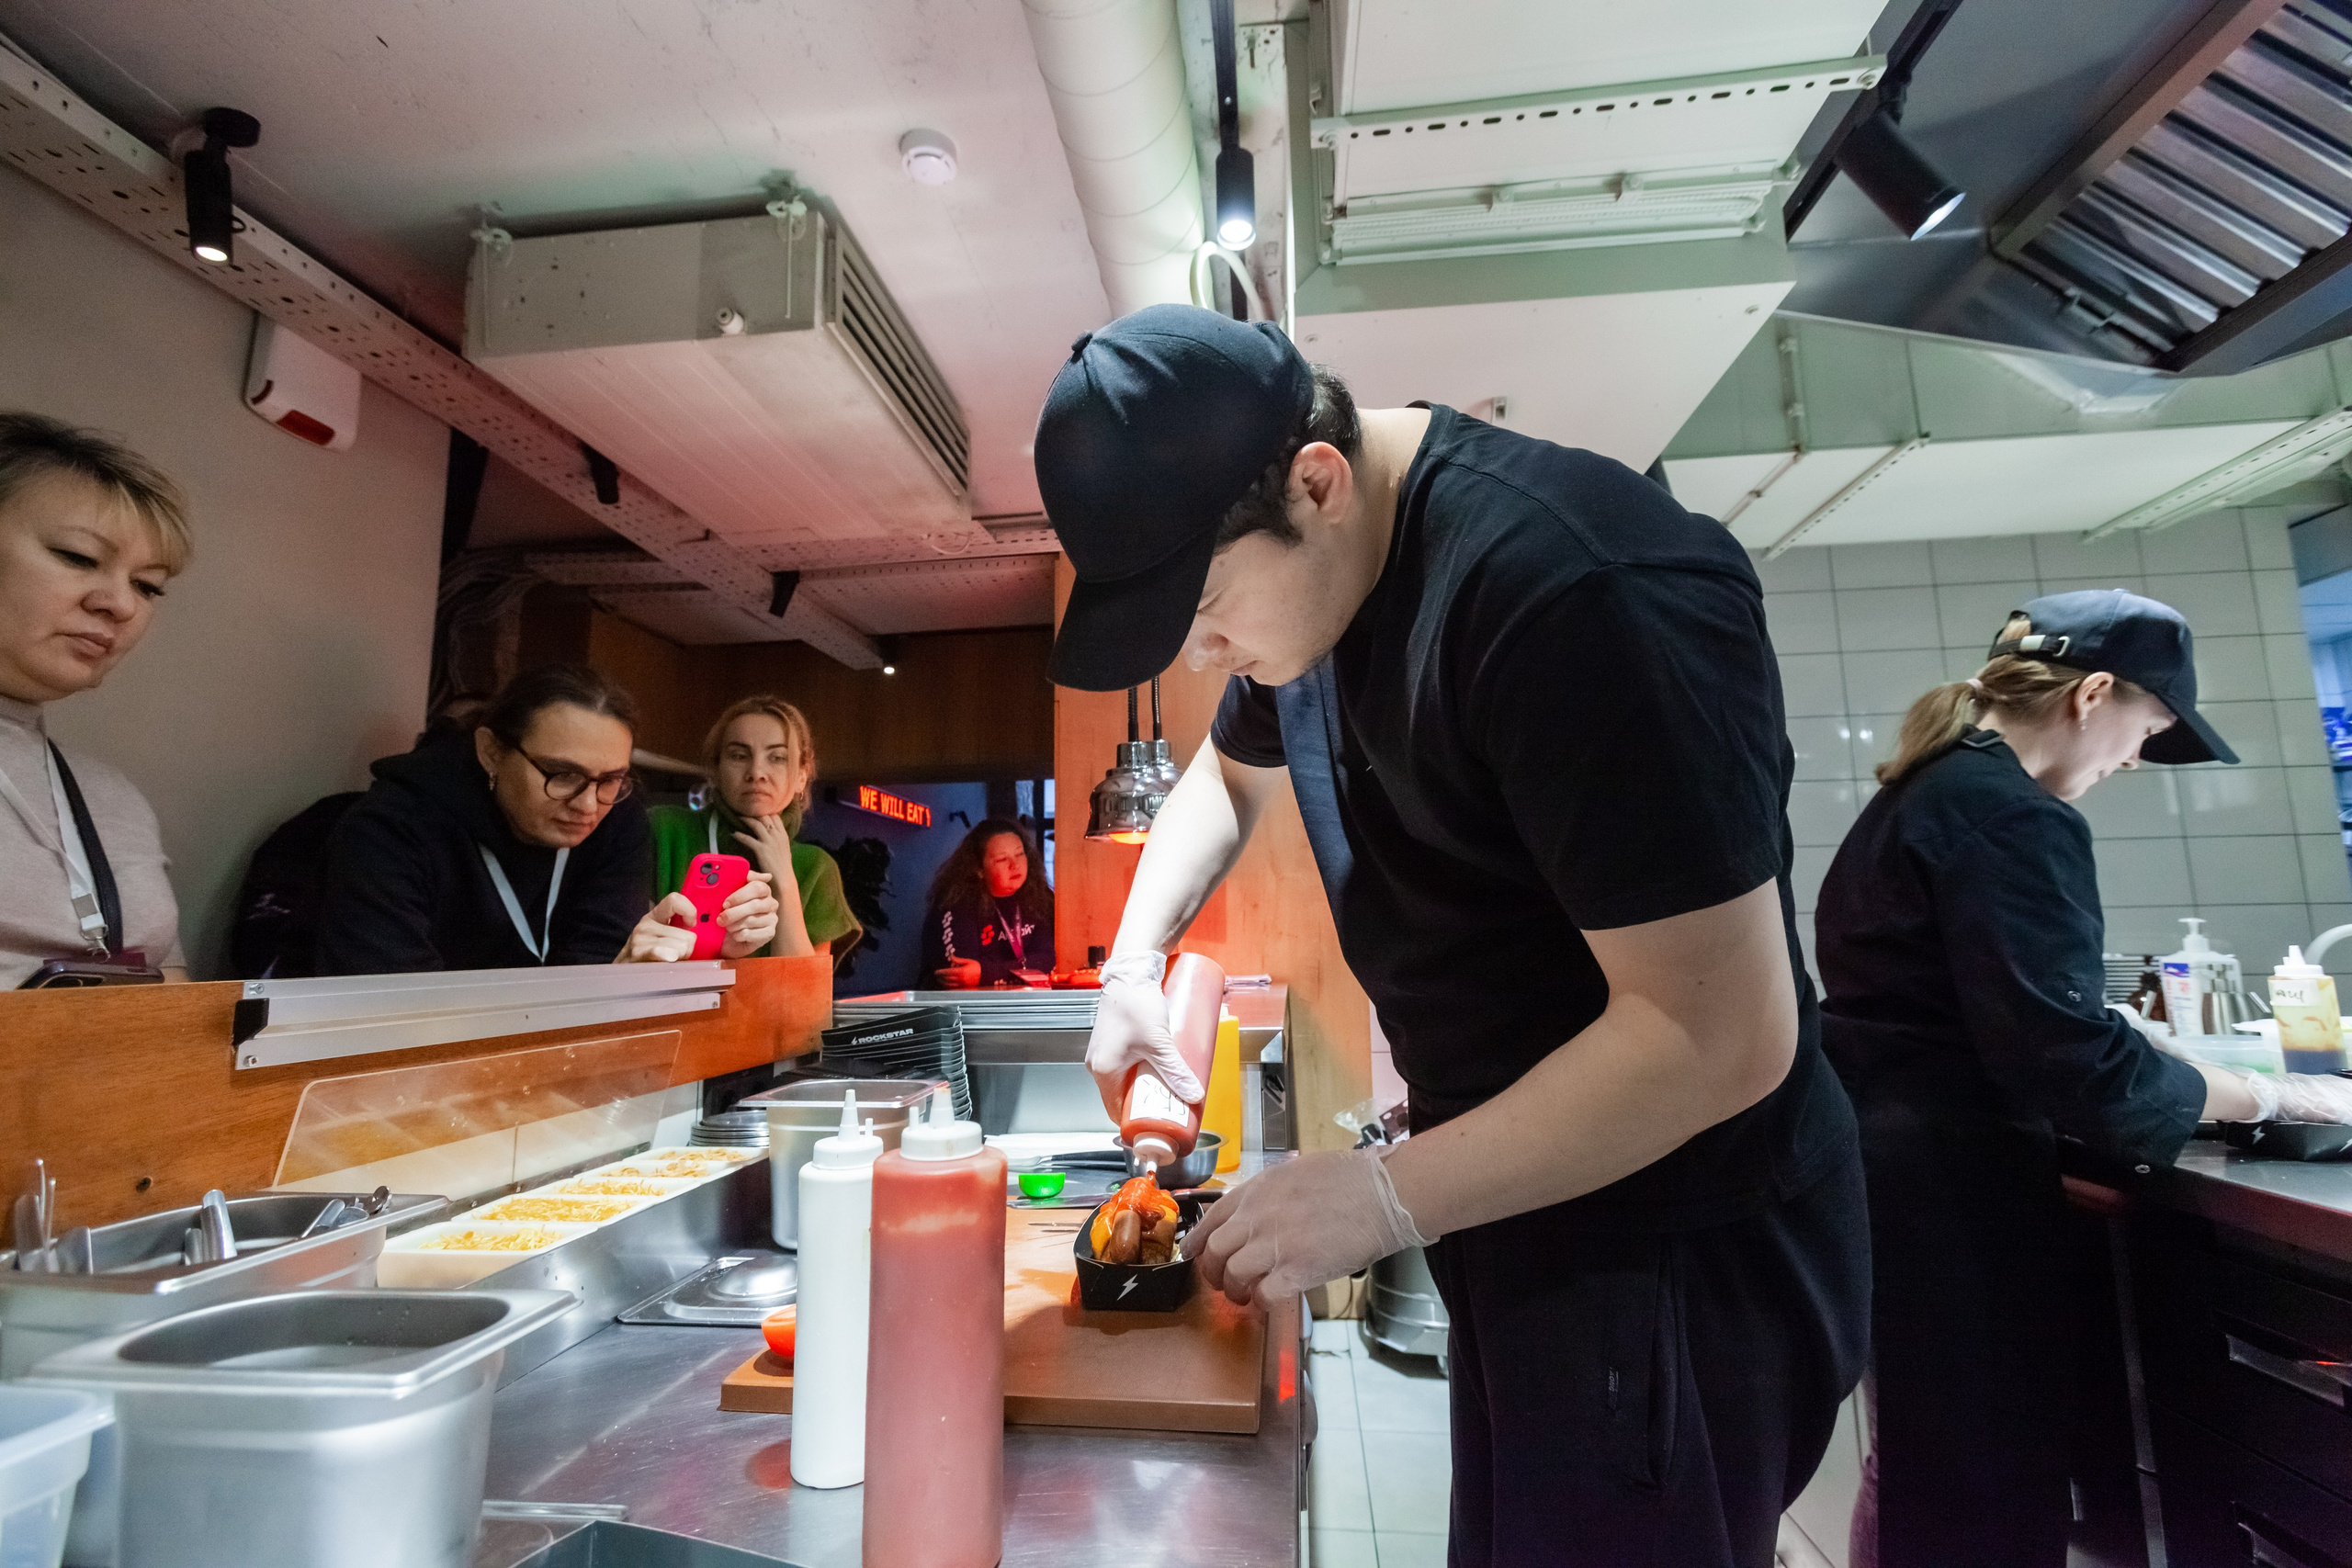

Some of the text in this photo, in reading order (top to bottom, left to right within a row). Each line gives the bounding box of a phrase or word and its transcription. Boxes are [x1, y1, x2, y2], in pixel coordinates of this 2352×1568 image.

[860, 785, 878, 812] WE
[880, 792, 905, 819] WILL
[906, 801, 925, 825] EAT
[858, 1028, 914, 1044] ROCKSTAR
